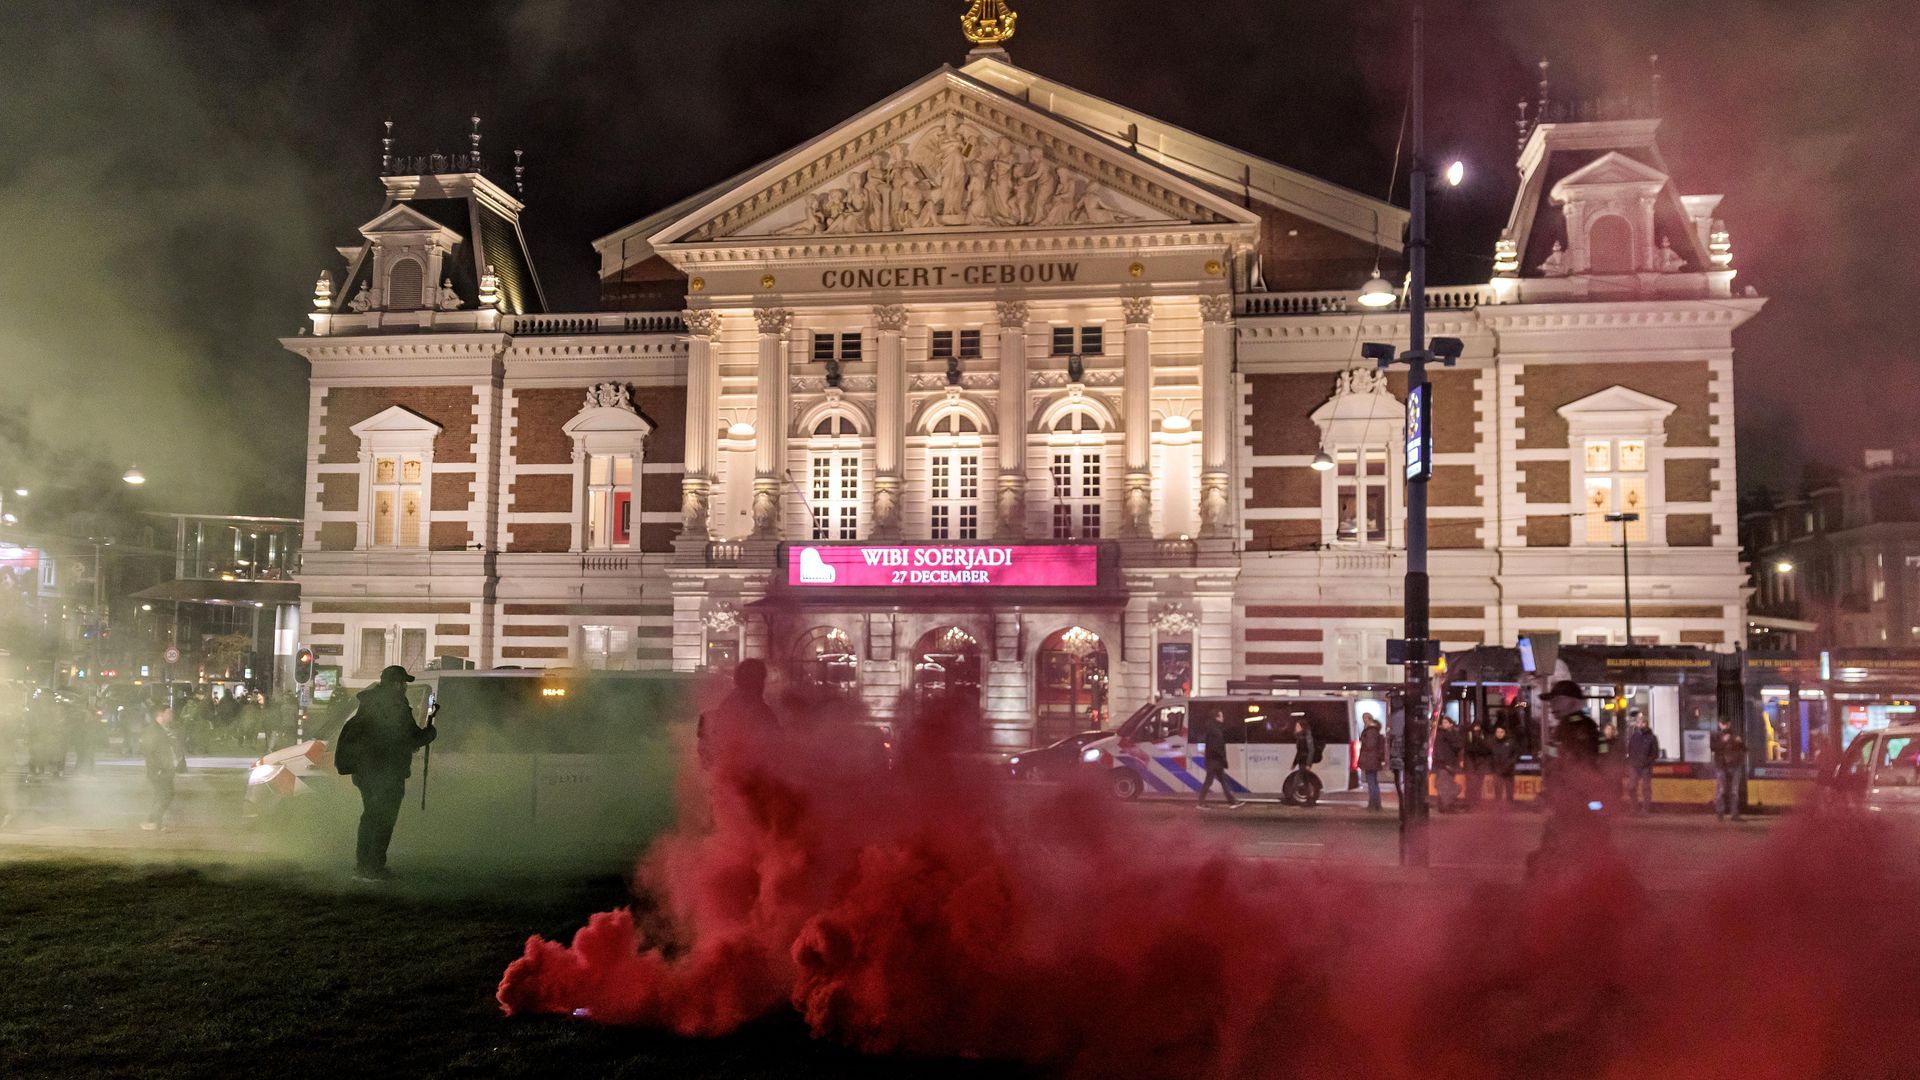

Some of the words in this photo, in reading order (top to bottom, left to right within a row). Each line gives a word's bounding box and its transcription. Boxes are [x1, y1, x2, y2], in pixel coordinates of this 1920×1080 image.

[821, 262, 1079, 289] CONCERT-GEBOUW
[861, 548, 909, 566] WIBI
[913, 548, 1013, 569] SOERJADI
[891, 570, 908, 583] 27
[910, 570, 990, 583] DECEMBER
